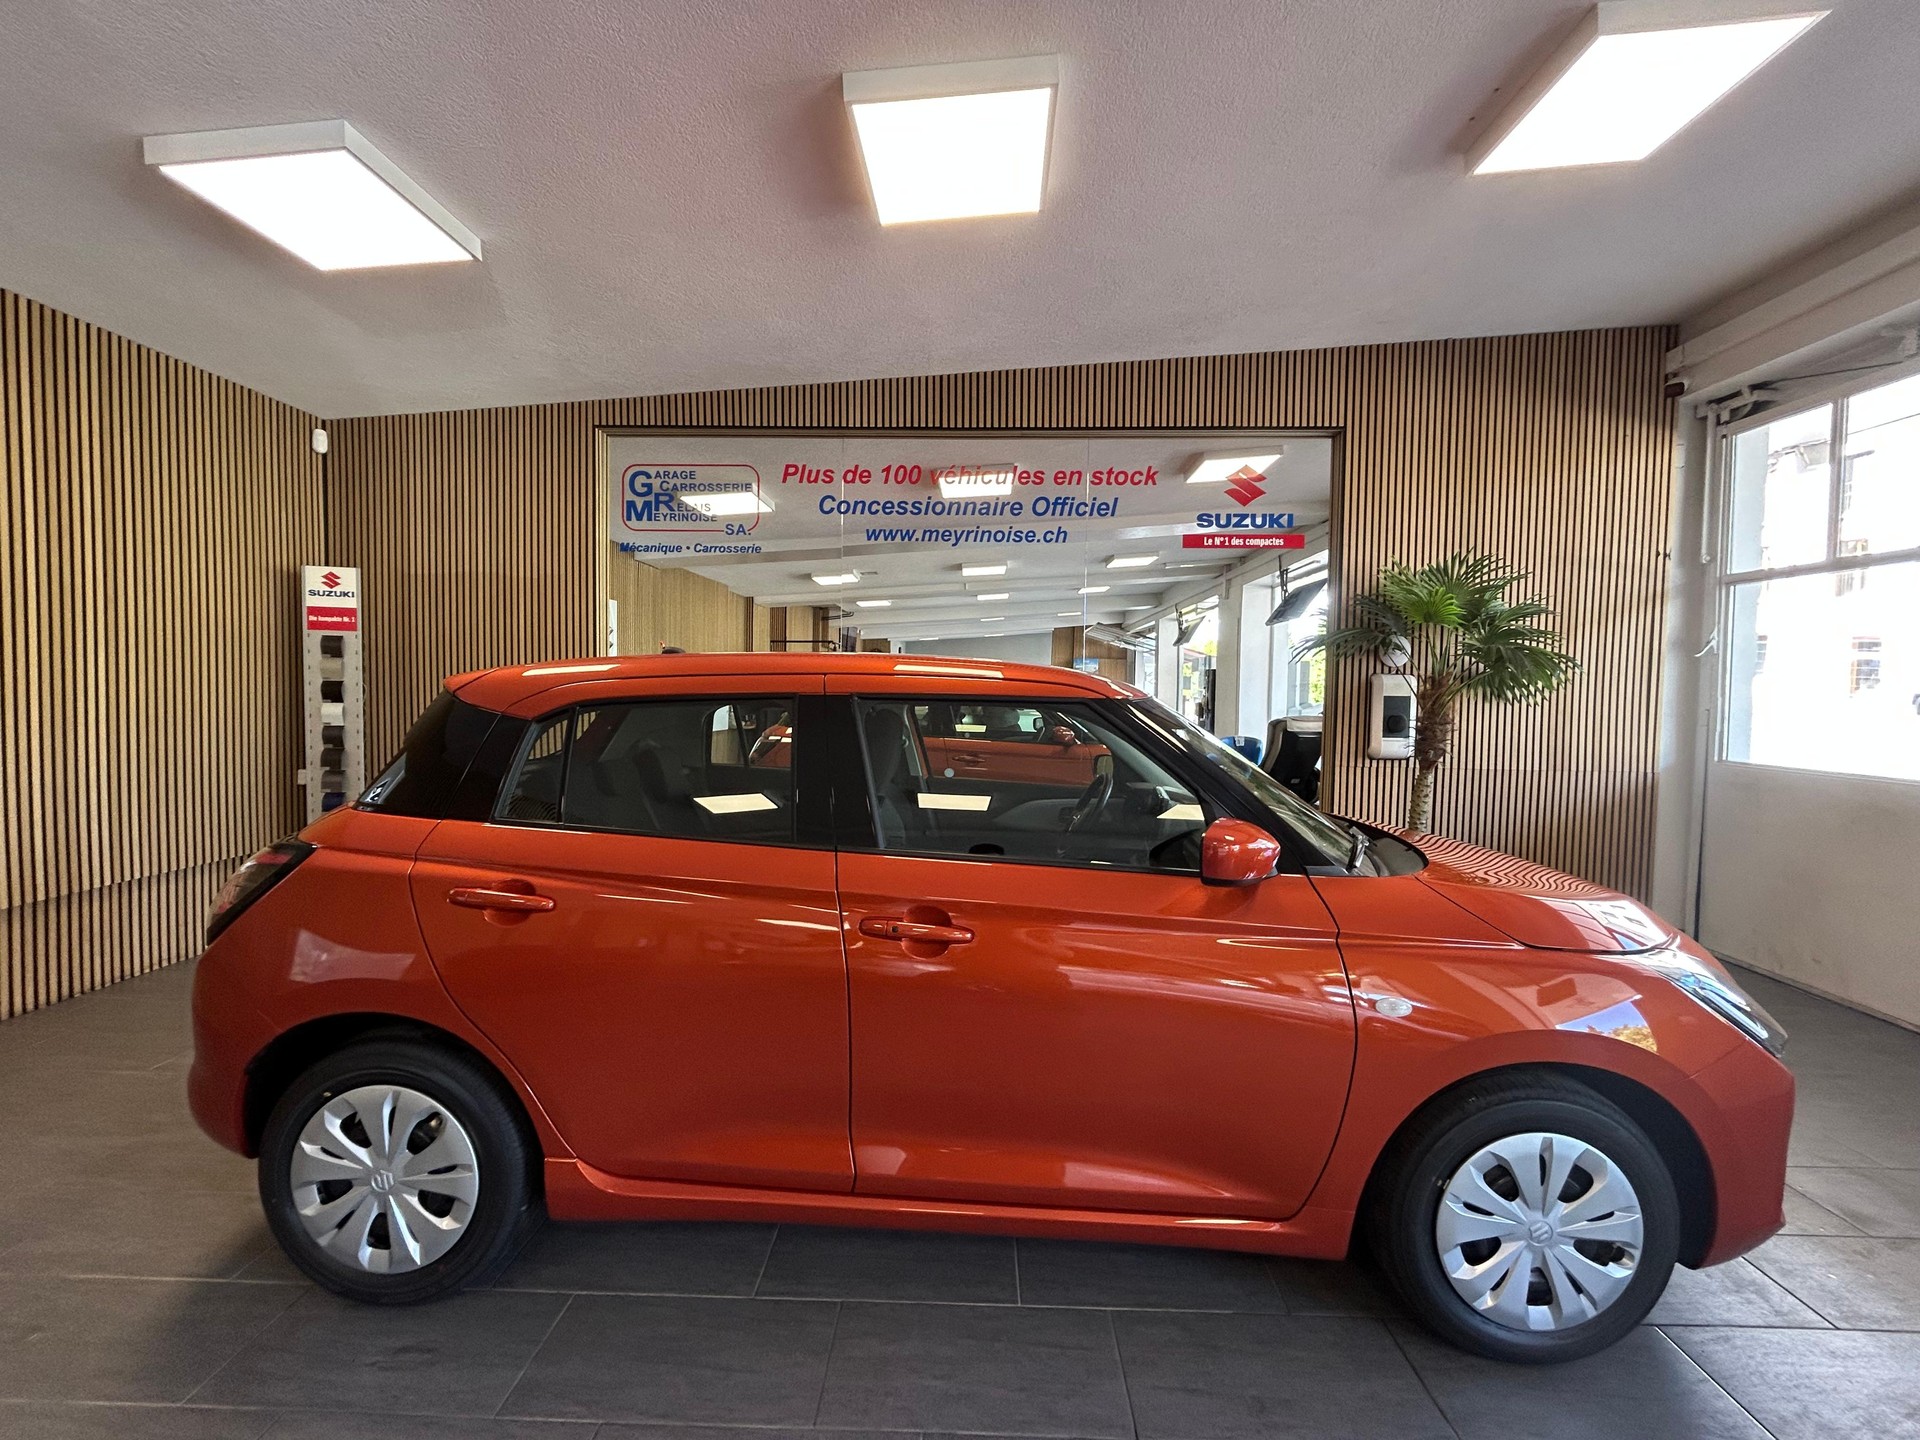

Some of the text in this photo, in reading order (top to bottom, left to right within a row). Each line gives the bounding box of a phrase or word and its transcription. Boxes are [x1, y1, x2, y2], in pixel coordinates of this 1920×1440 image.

[629, 470, 696, 498] GARAGE
[782, 463, 1159, 487] Plus de 100 véhicules en stock
[660, 480, 753, 493] CARROSSERIE
[626, 500, 718, 522] MEYRINOISE
[819, 494, 1119, 517] Concessionnaire Officiel
[1196, 512, 1294, 529] SUZUKI
[865, 525, 1068, 547] www.meyrinoise.ch
[1203, 536, 1213, 546] Le
[1231, 536, 1244, 546] des
[1245, 536, 1284, 548] compactes
[620, 542, 762, 555] Mécanique Carrosserie
[308, 589, 355, 598] SUZUKI
